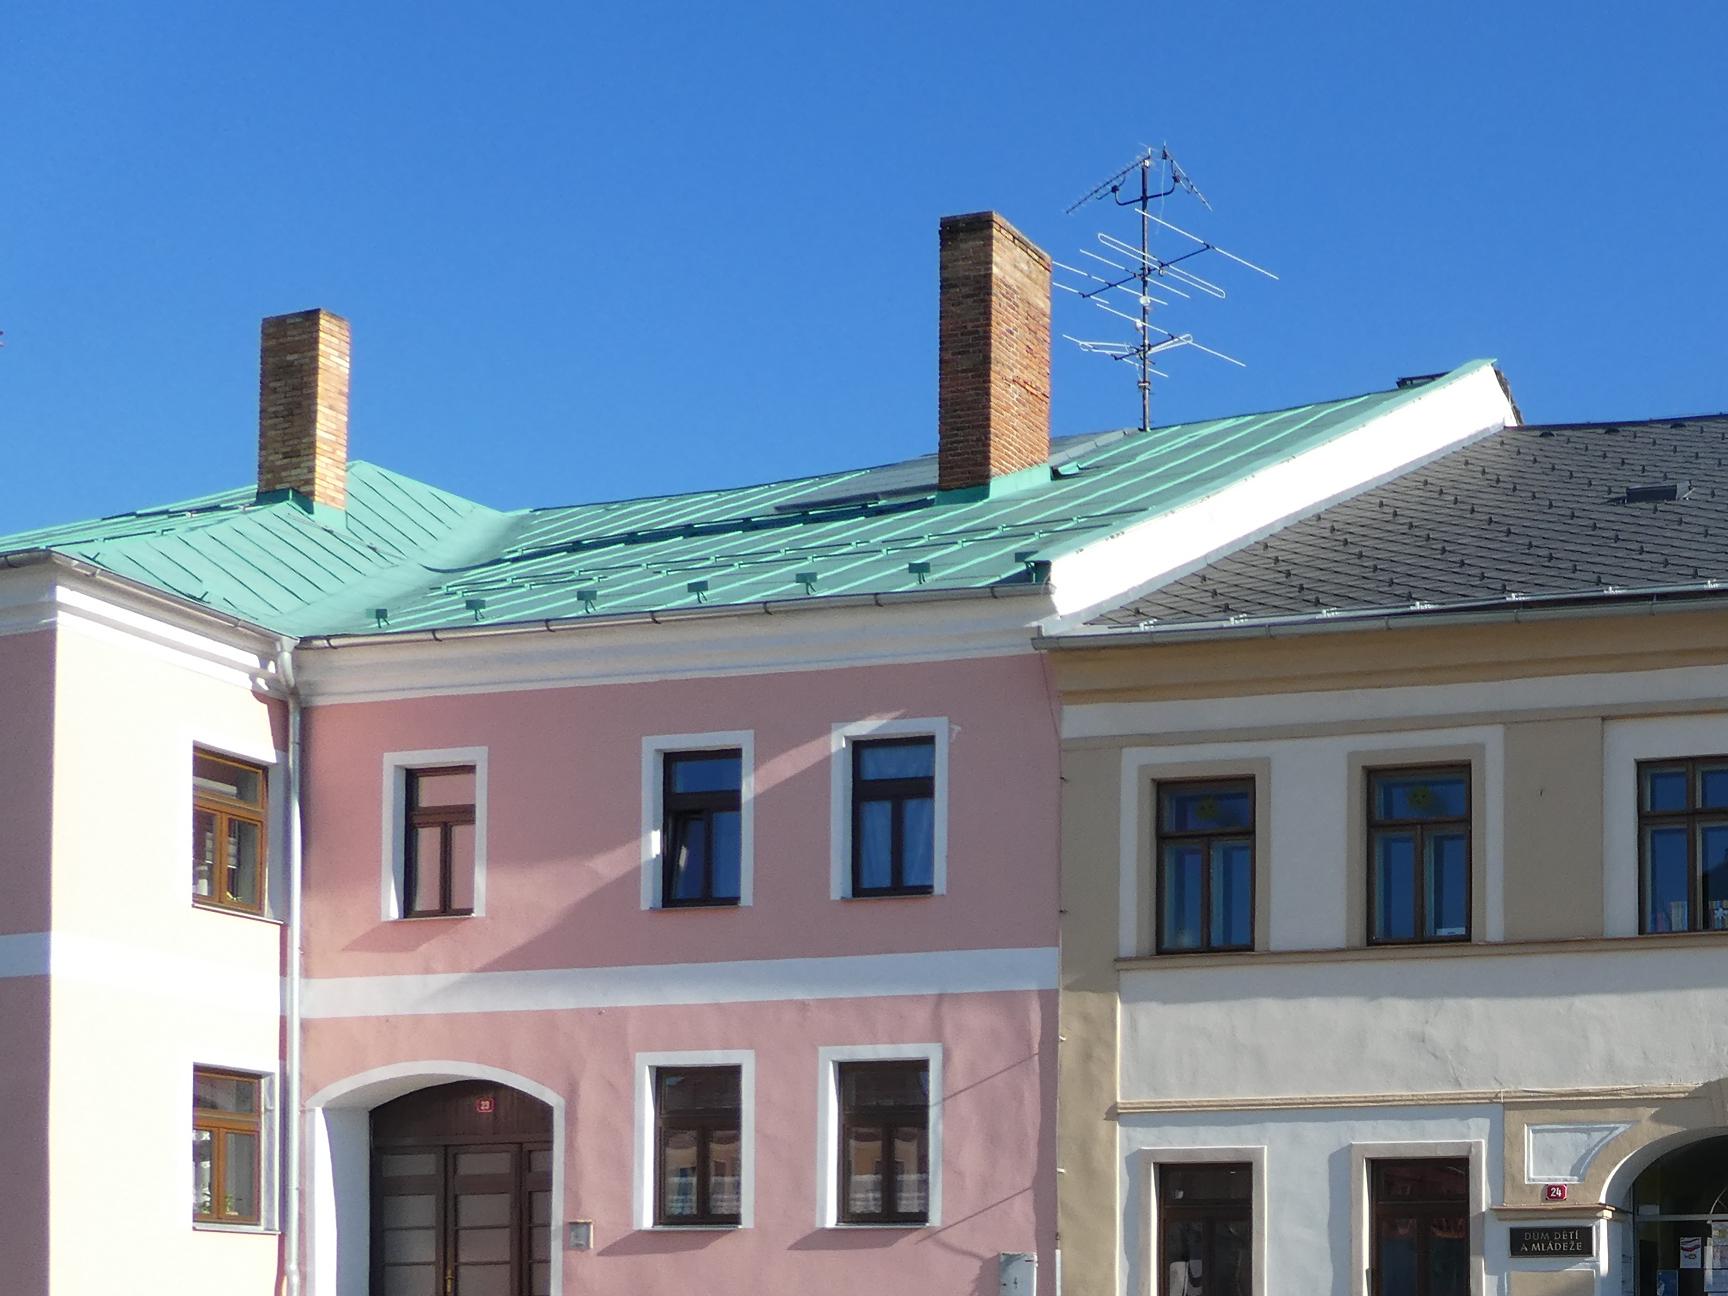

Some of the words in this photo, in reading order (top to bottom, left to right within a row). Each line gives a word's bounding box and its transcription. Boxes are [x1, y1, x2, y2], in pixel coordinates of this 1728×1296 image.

[1550, 1187, 1562, 1197] 24
[1520, 1242, 1528, 1252] A
[1531, 1240, 1583, 1252] MLÁDEŽE
